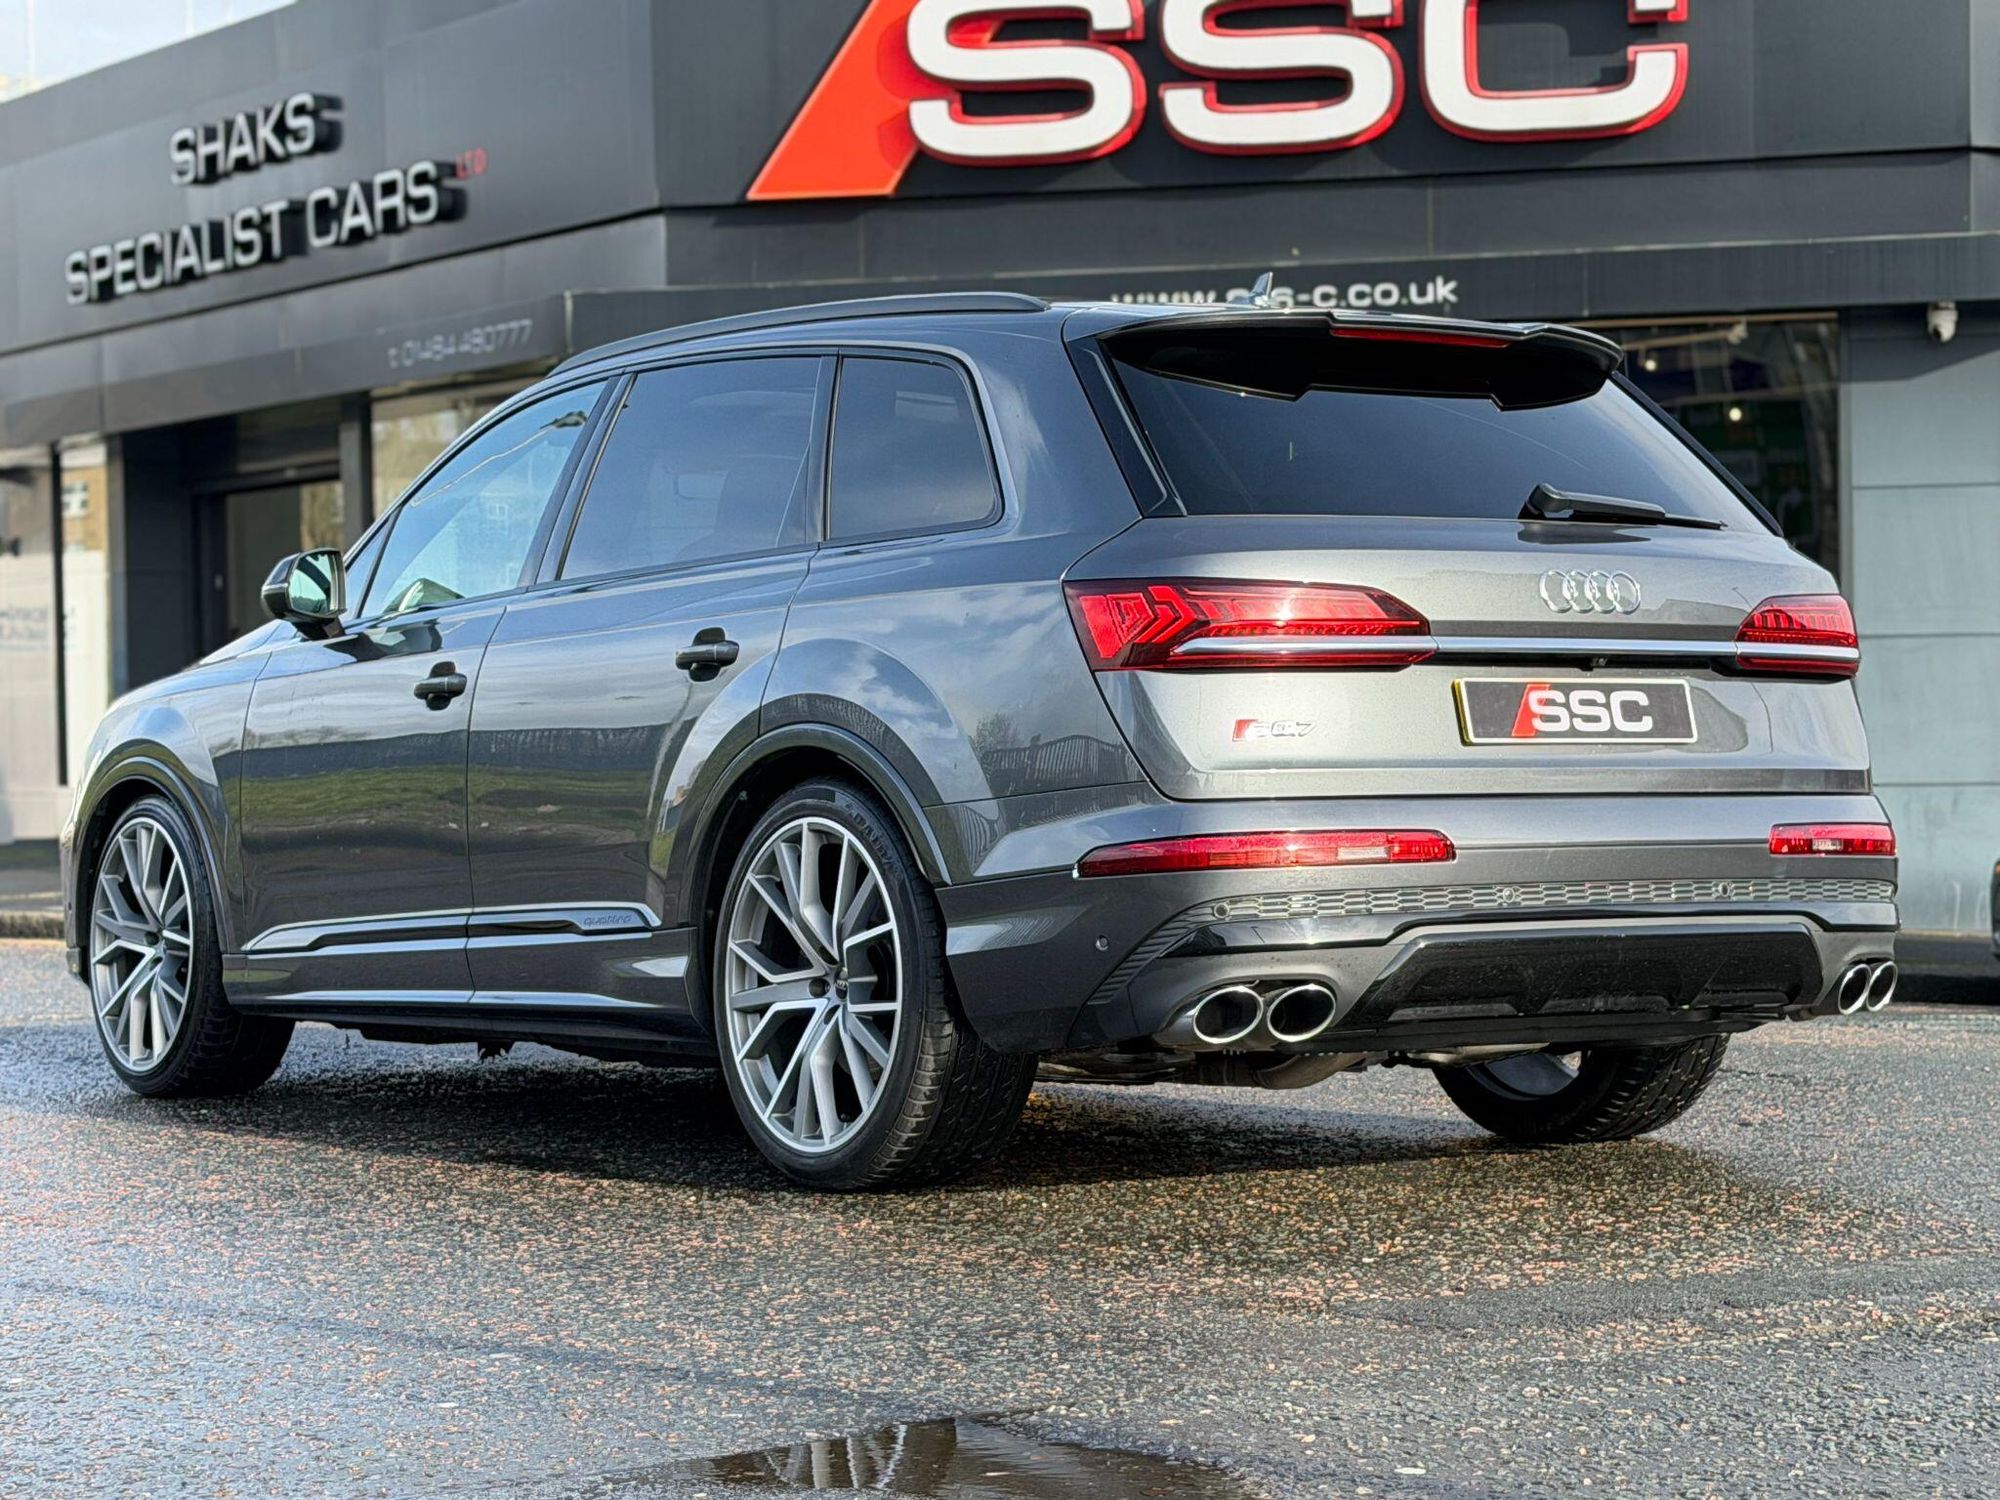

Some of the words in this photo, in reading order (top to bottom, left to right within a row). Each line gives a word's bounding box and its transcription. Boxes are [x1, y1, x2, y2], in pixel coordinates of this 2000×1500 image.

[169, 92, 317, 186] SHAKS
[905, 0, 1690, 167] SSC
[64, 200, 290, 305] SPECIALIST
[306, 160, 441, 248] CARS
[456, 147, 488, 180] LTD
[1528, 689, 1654, 732] SSC
